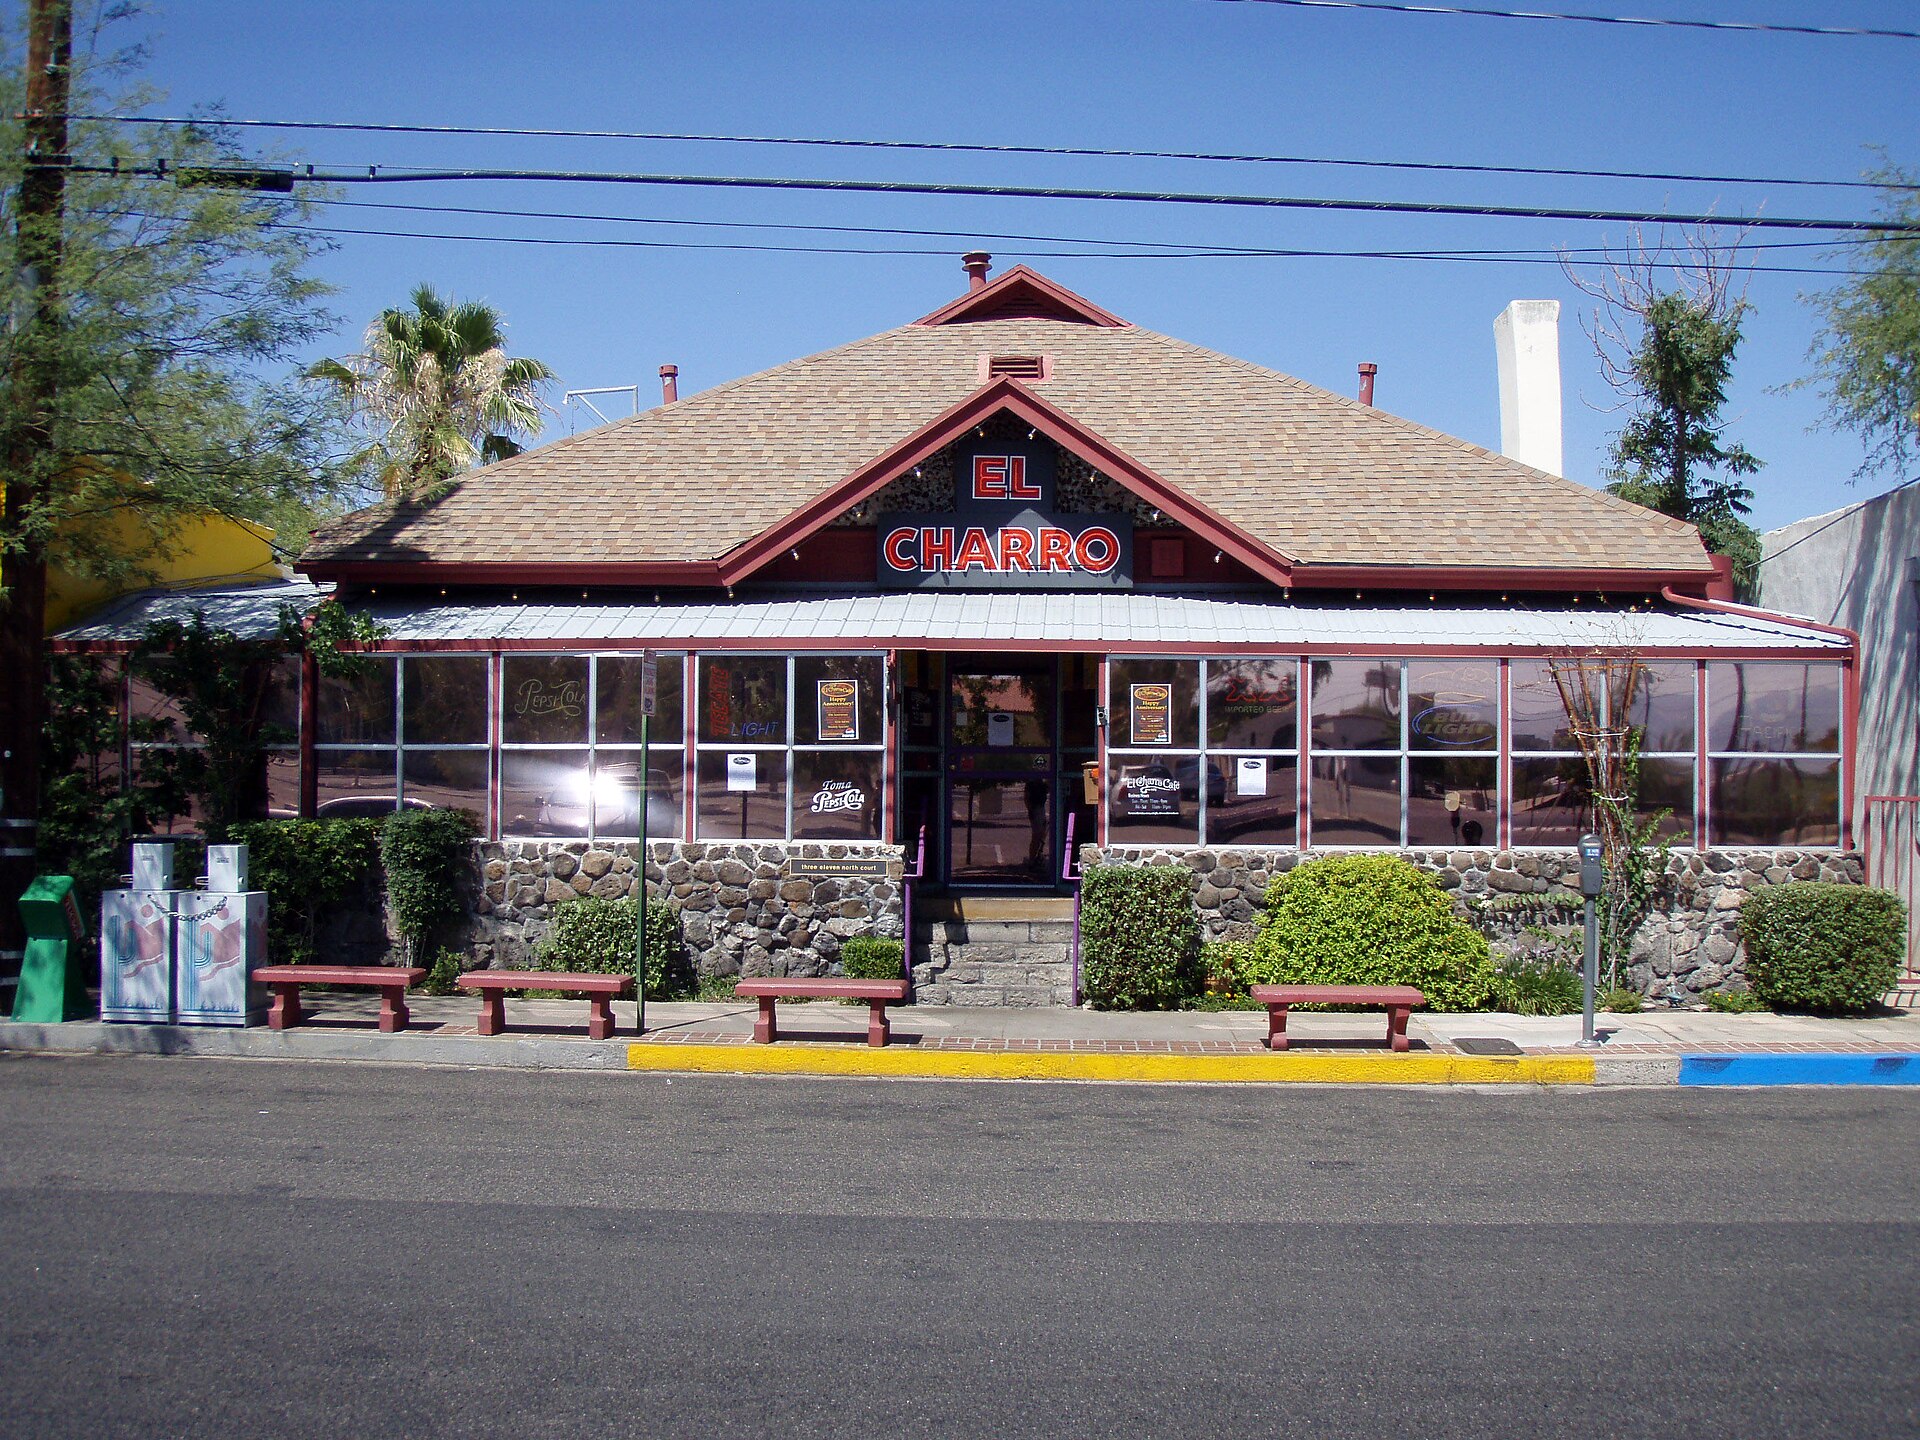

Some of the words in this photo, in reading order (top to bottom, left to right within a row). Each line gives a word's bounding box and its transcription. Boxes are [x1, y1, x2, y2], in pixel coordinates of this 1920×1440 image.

[972, 455, 1042, 500] EL
[883, 526, 1121, 574] CHARRO
[730, 721, 779, 737] LIGHT
[1422, 723, 1491, 735] LIGHT
[822, 780, 852, 791] Toma
[1127, 777, 1136, 789] El
